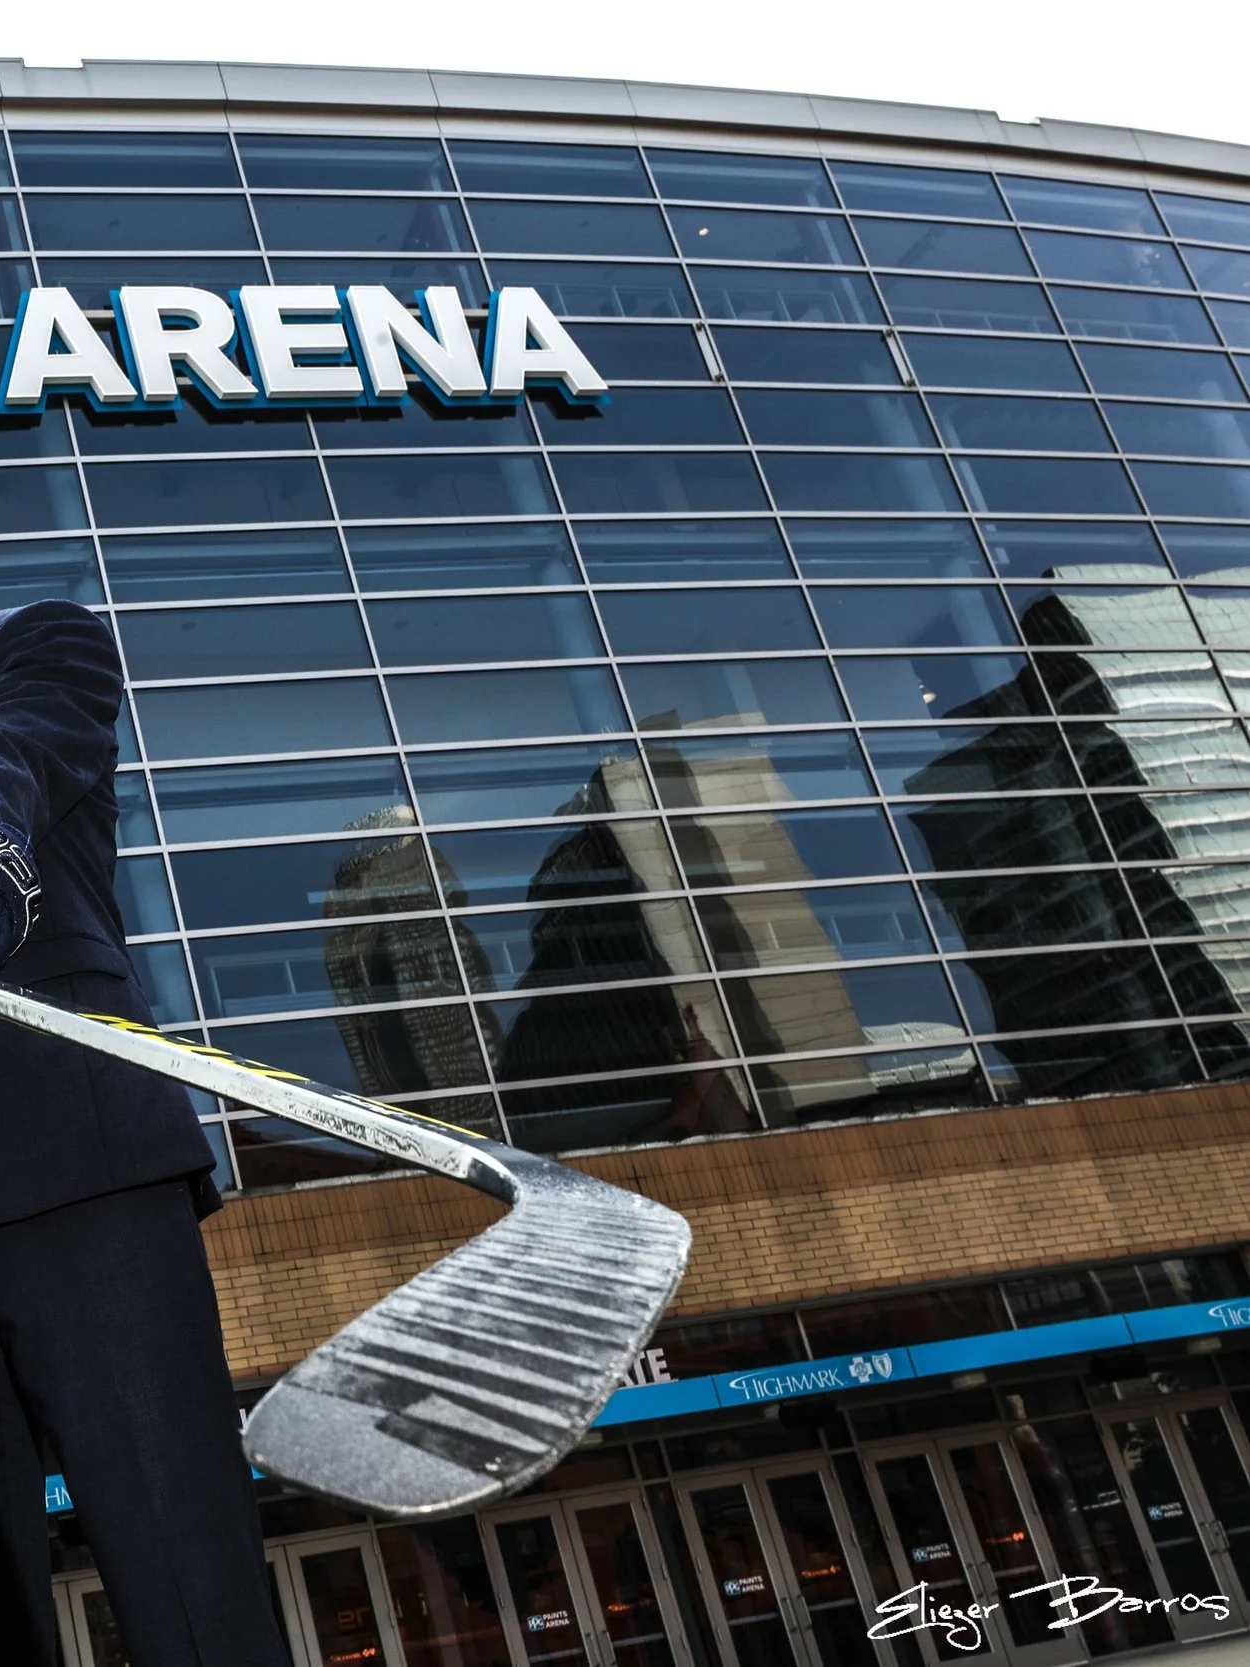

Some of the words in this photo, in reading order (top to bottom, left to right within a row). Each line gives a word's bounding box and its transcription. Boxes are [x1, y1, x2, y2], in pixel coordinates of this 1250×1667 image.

[3, 285, 611, 406] ARENA
[729, 1368, 844, 1400] HIGHMARK
[542, 1610, 568, 1620] PAINTS
[546, 1618, 570, 1629] ARENA
